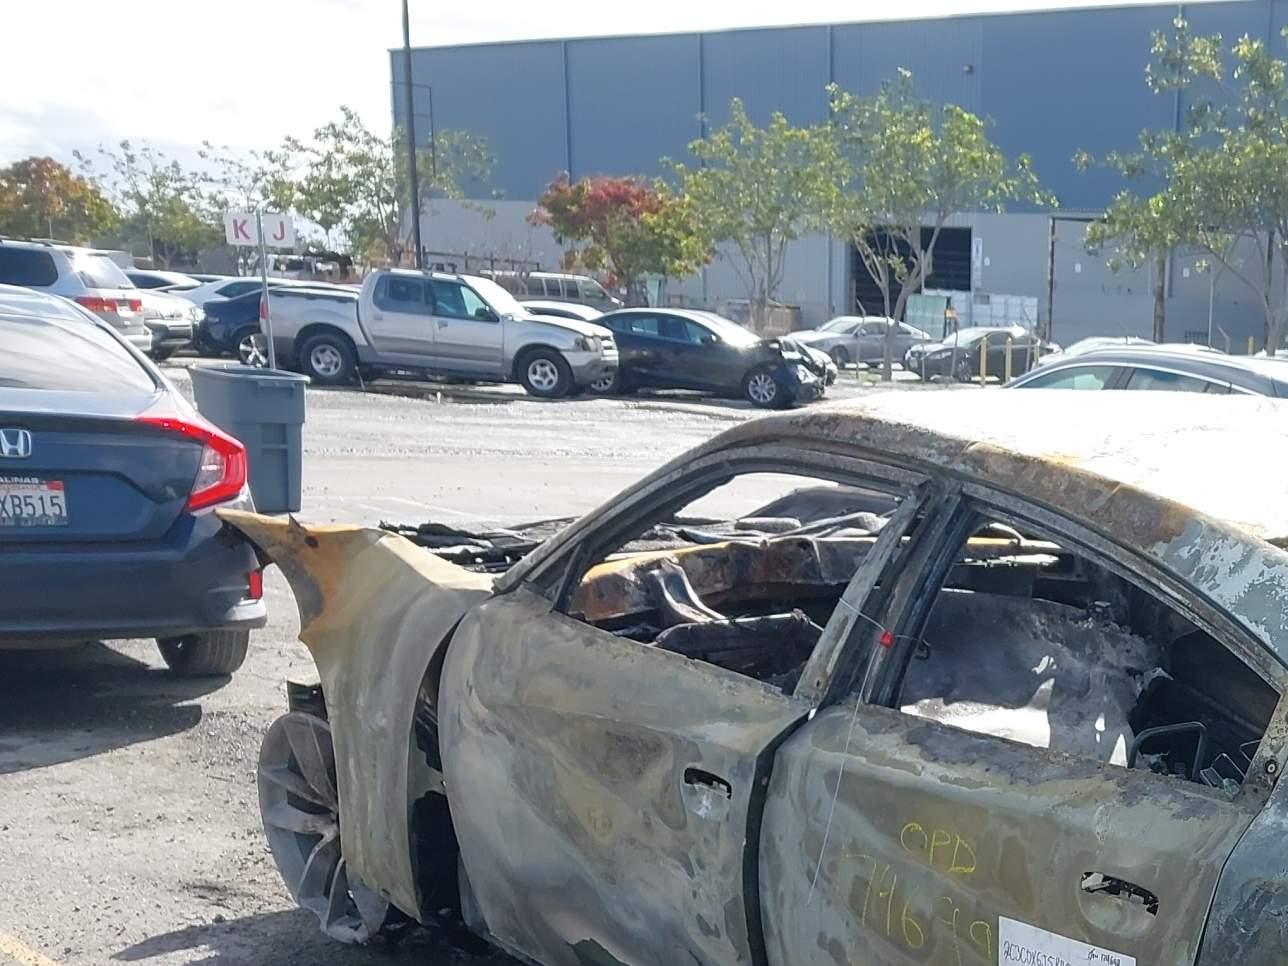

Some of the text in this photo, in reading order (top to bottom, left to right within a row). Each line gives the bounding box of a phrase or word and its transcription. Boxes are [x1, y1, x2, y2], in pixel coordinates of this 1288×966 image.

[233, 219, 250, 240] K
[273, 221, 285, 241] J
[901, 822, 977, 873] OPD
